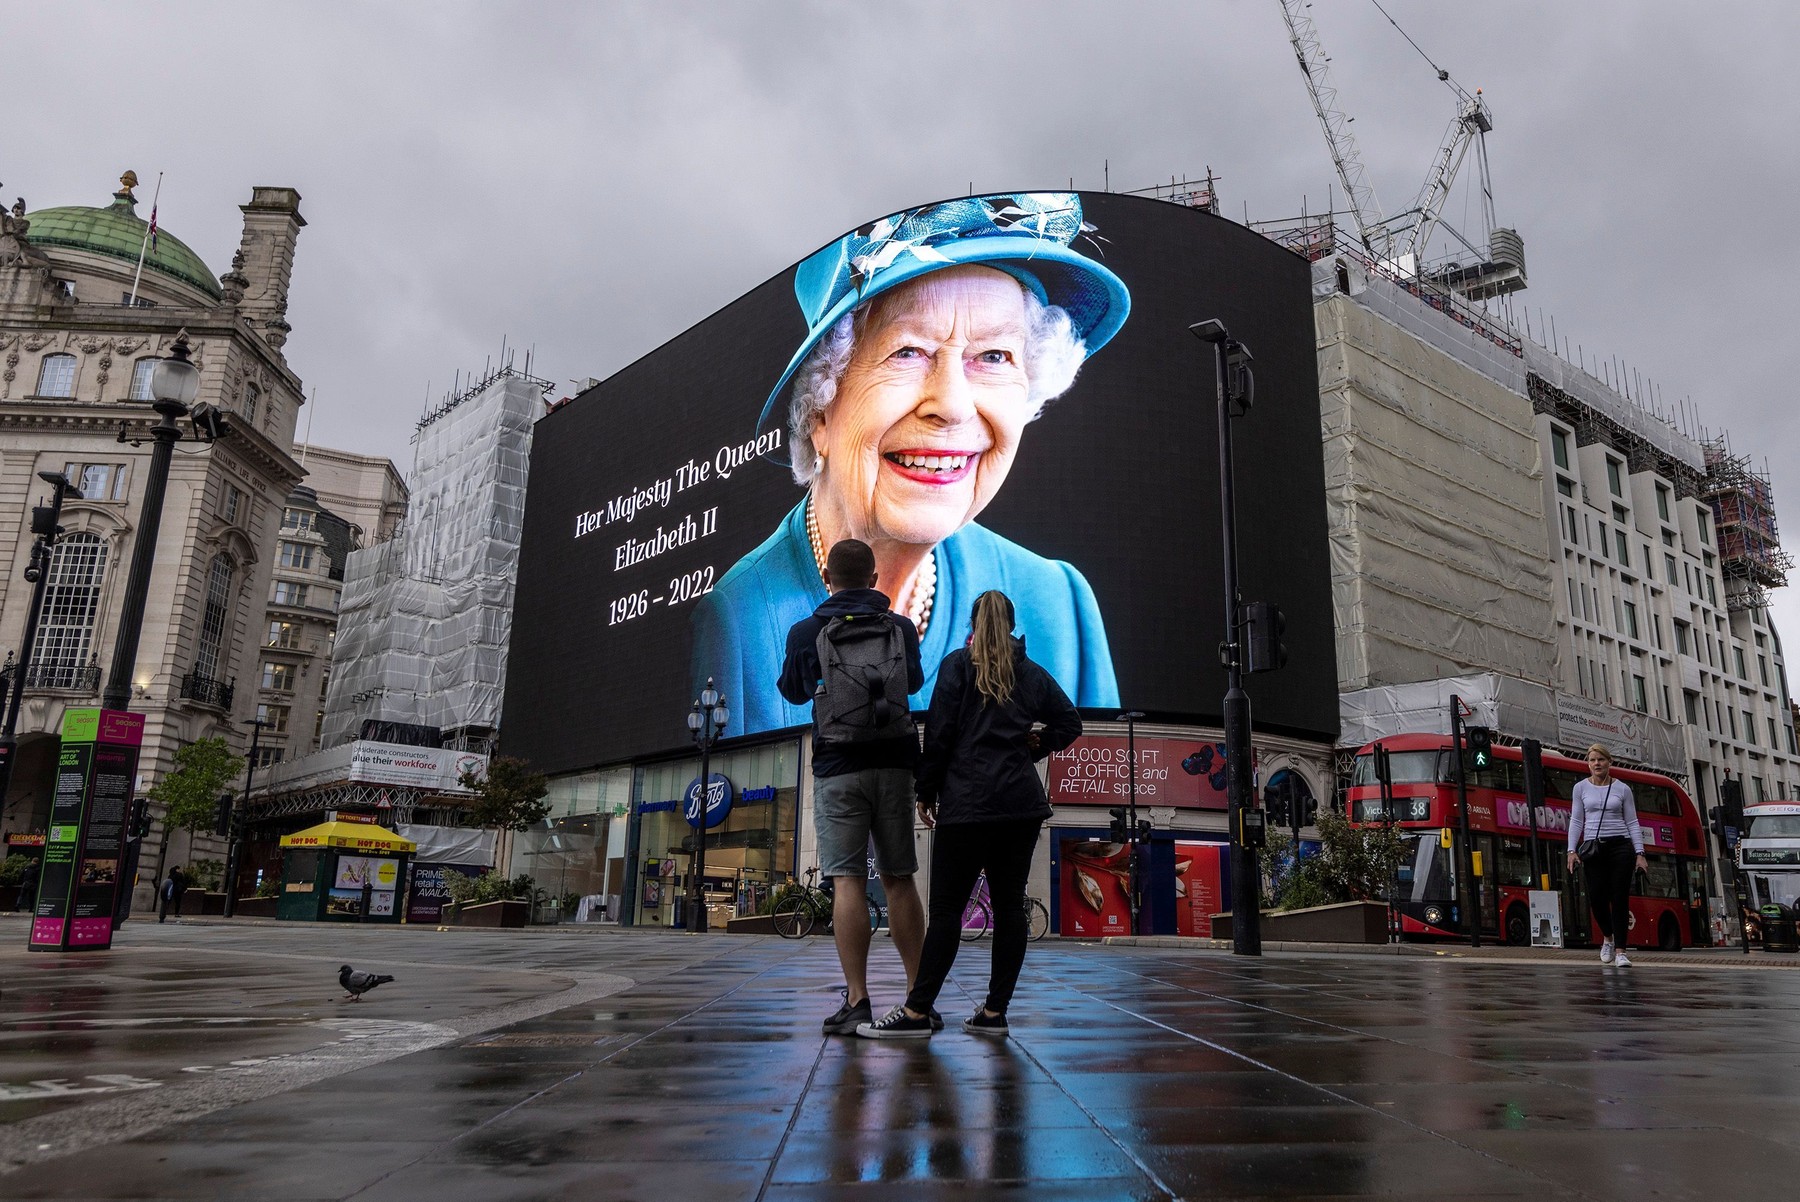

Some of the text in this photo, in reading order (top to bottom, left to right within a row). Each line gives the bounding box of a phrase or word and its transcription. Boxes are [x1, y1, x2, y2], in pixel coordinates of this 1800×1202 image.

[214, 449, 266, 493] ALLIANCE LIFE OFFICE
[574, 428, 782, 538] Her Majesty The Queen
[614, 506, 718, 572] Elizabeth II
[608, 589, 648, 626] 1926
[668, 566, 714, 606] 2022
[1560, 712, 1579, 724] protect
[1579, 715, 1588, 726] the
[353, 754, 437, 770] alue their workforce
[389, 750, 429, 760] constructors
[1052, 748, 1159, 764] 144,000 SQ FT
[1067, 764, 1169, 780] of OFFICE and
[742, 785, 776, 801] beauty
[1059, 779, 1156, 796] RETAIL space
[686, 781, 725, 820] Bots
[1411, 802, 1425, 815] 38
[1473, 806, 1490, 814] ARRIVA
[418, 888, 452, 897] AVAILA
